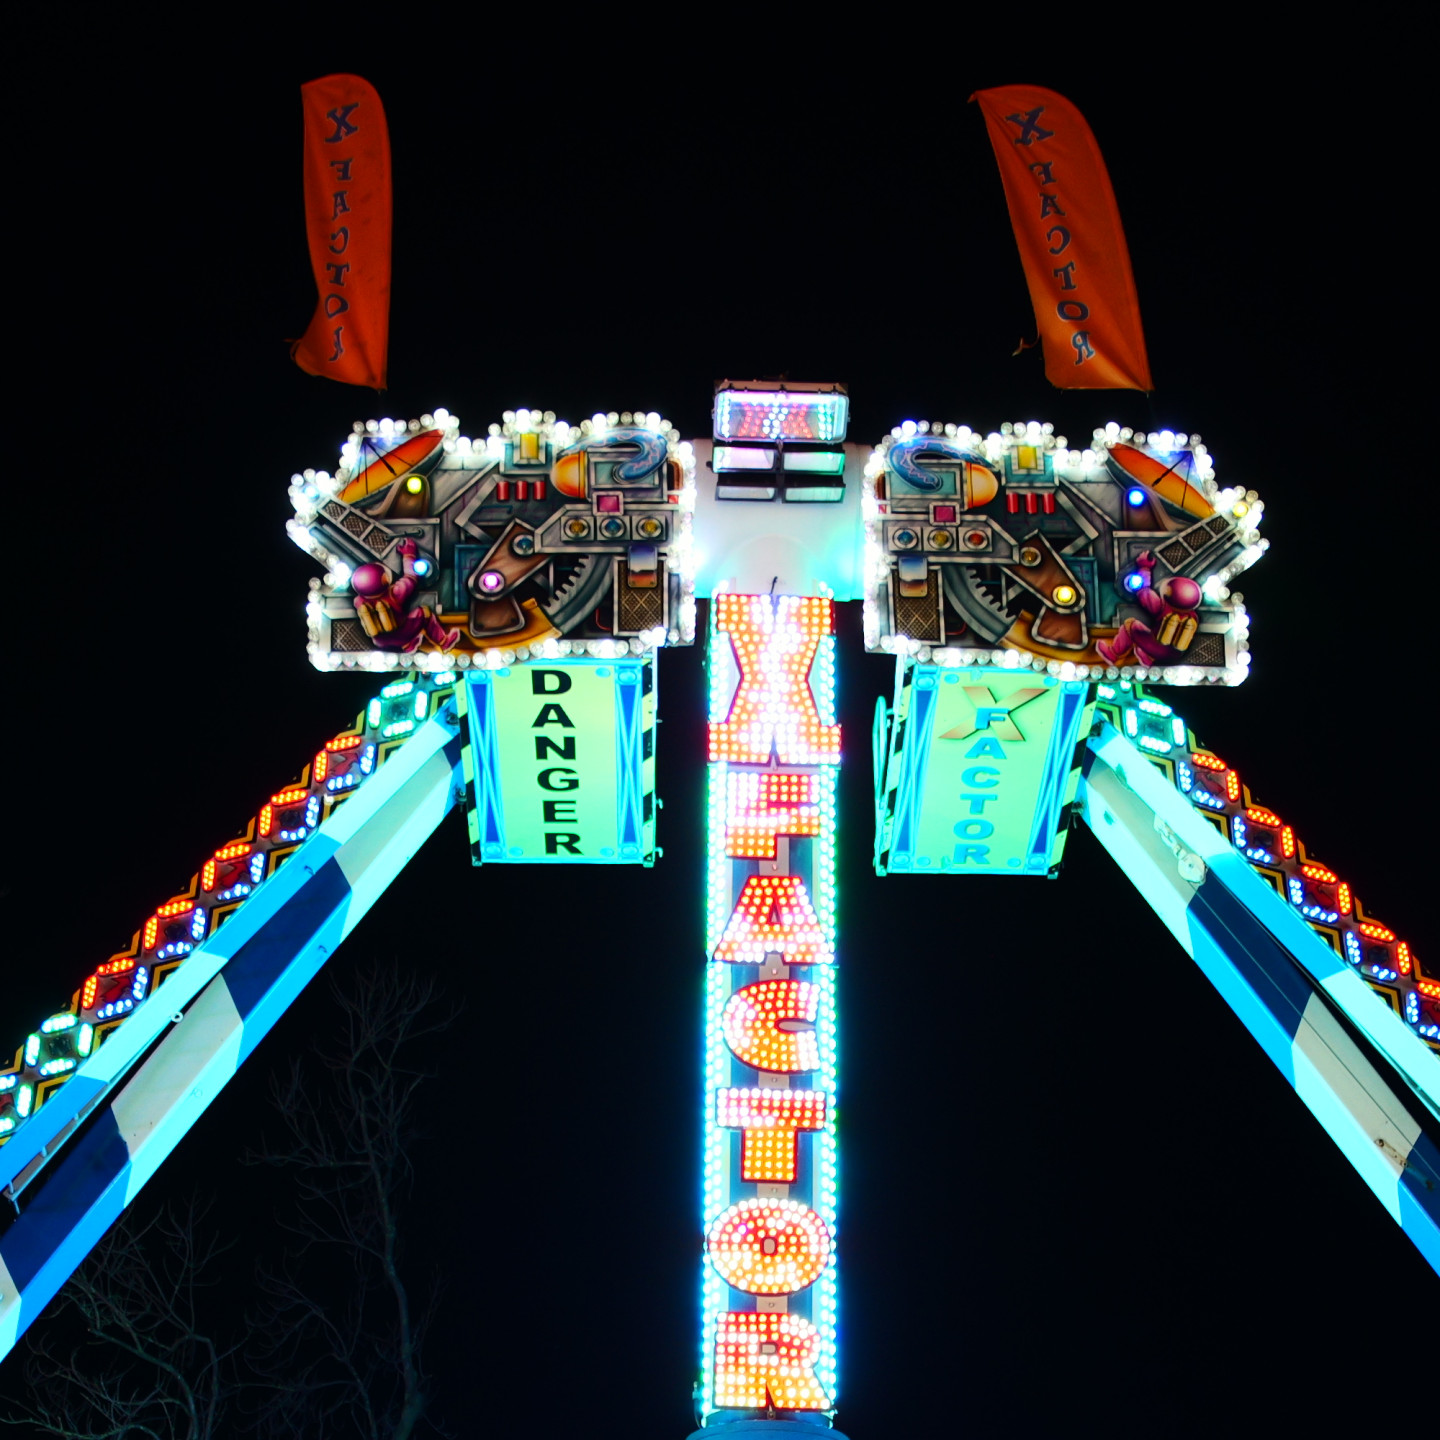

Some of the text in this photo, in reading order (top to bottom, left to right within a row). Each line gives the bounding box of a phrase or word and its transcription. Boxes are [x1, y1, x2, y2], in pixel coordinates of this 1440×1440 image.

[531, 669, 585, 856] DANGER
[938, 686, 1051, 865] X FACTOR
[707, 593, 842, 1412] X FACTOR
